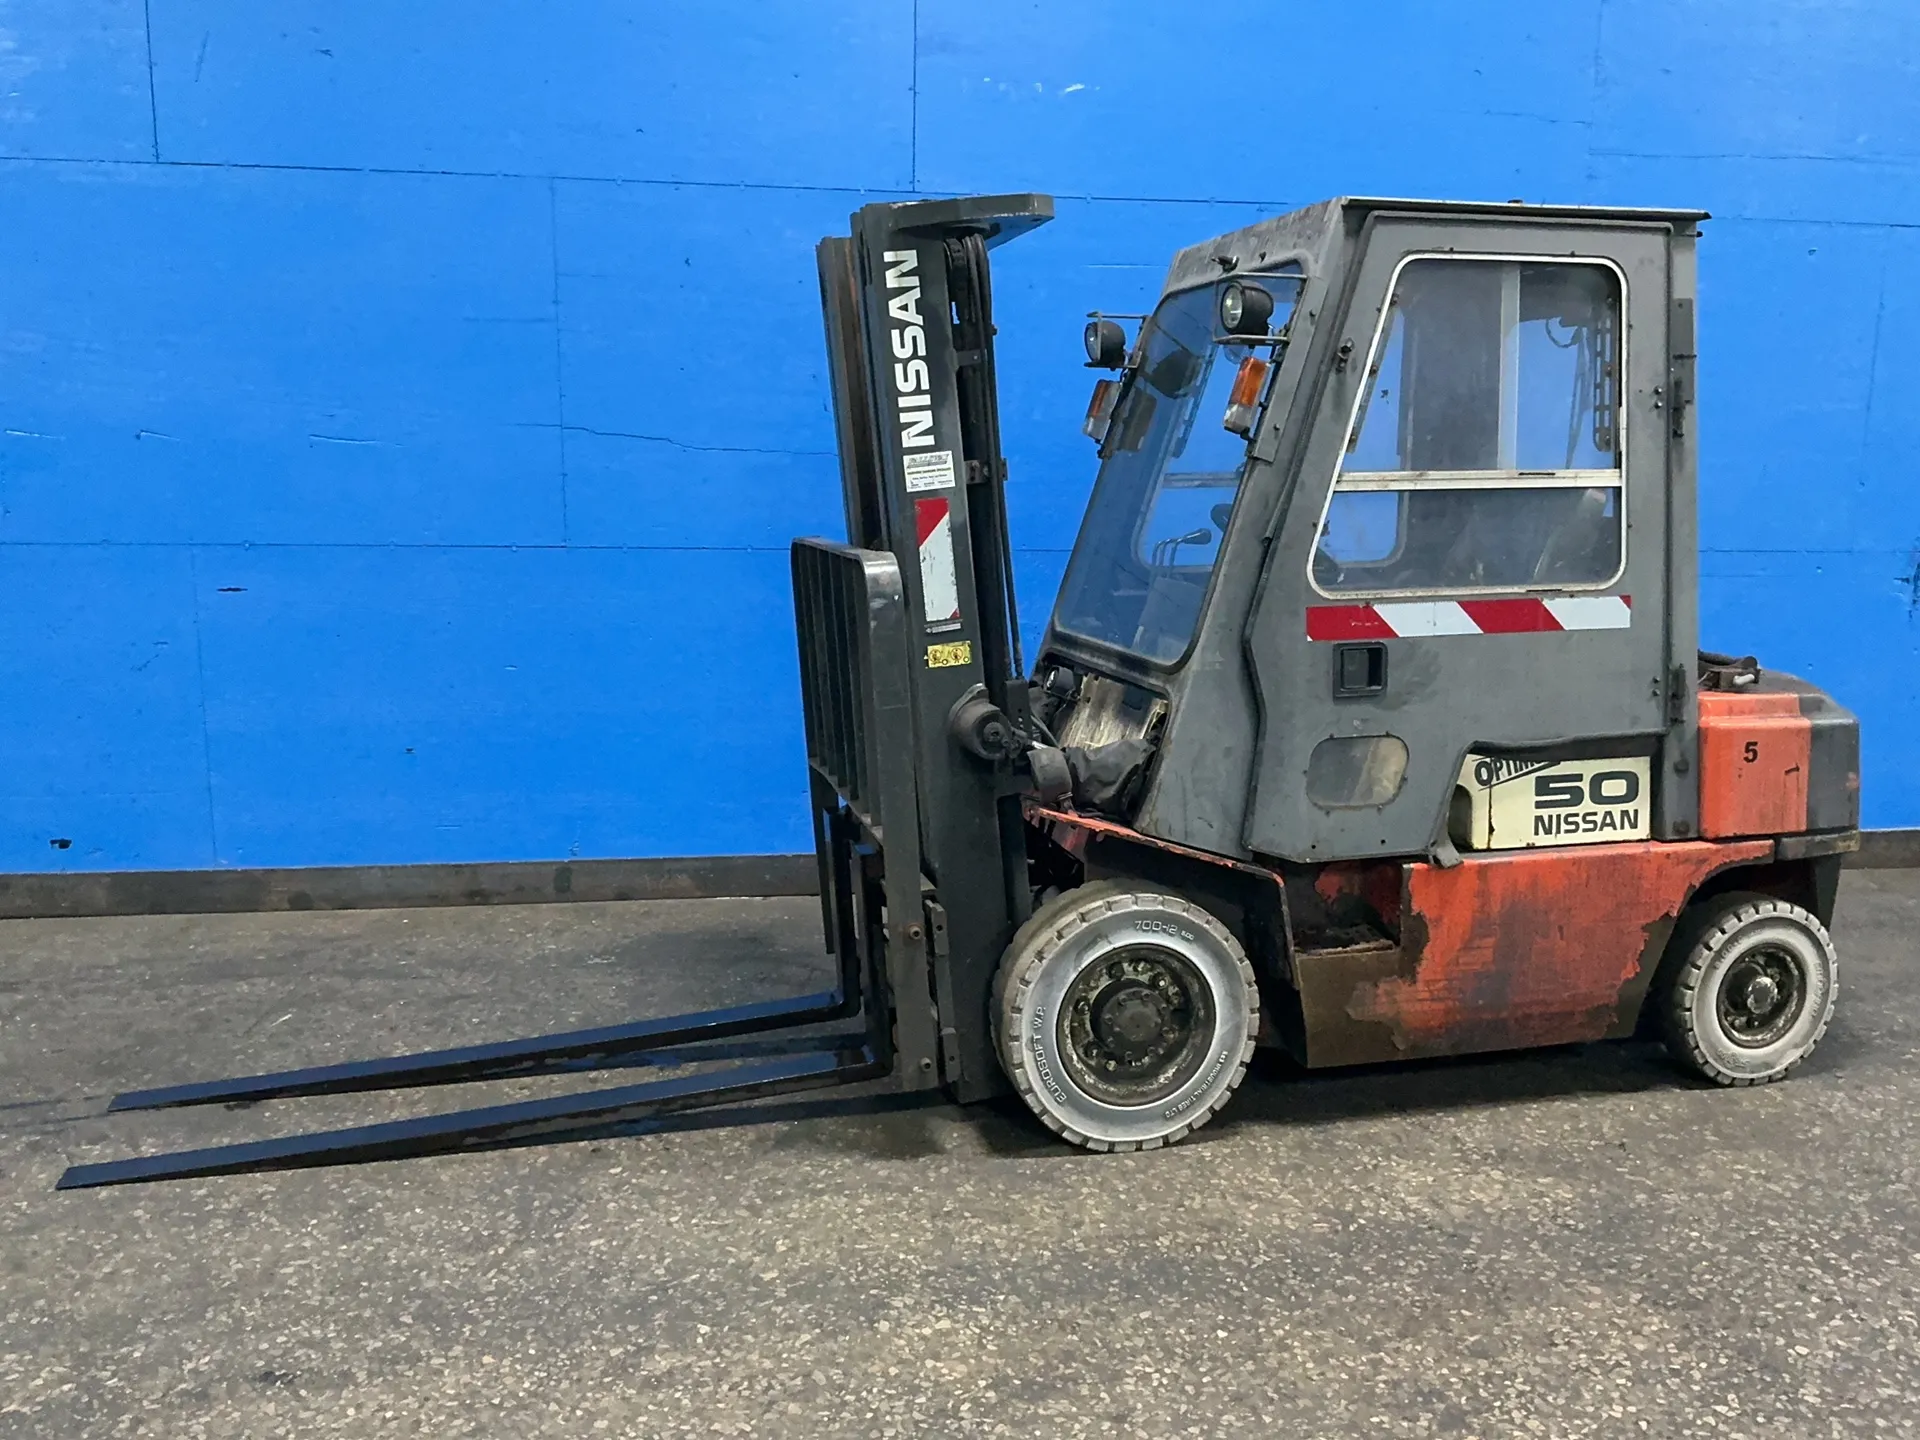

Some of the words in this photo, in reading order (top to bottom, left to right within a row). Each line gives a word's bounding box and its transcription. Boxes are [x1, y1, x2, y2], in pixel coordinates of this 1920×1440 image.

[883, 249, 936, 448] NISSAN
[1743, 741, 1759, 763] 5
[1534, 770, 1640, 809] 50
[1533, 808, 1639, 836] NISSAN
[1134, 920, 1179, 935] 700-12
[1033, 1033, 1067, 1103] EUROSOFT
